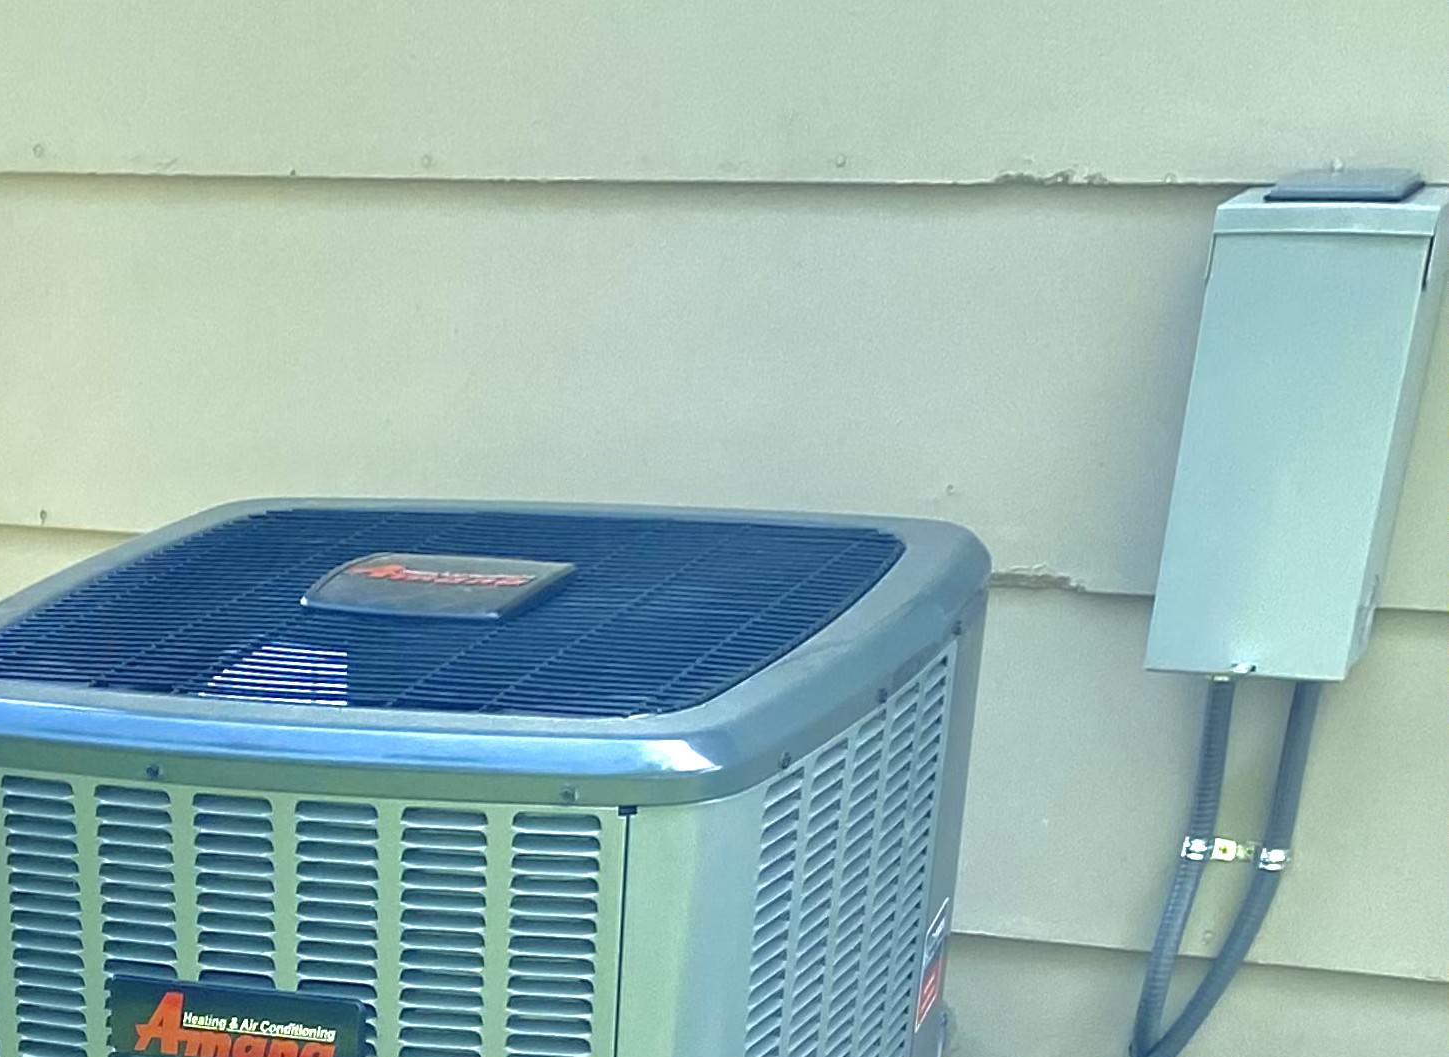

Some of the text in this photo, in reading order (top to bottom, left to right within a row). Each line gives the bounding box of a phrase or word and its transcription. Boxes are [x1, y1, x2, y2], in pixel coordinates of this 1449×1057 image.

[182, 1011, 336, 1042] Heating & Air Conditioning
